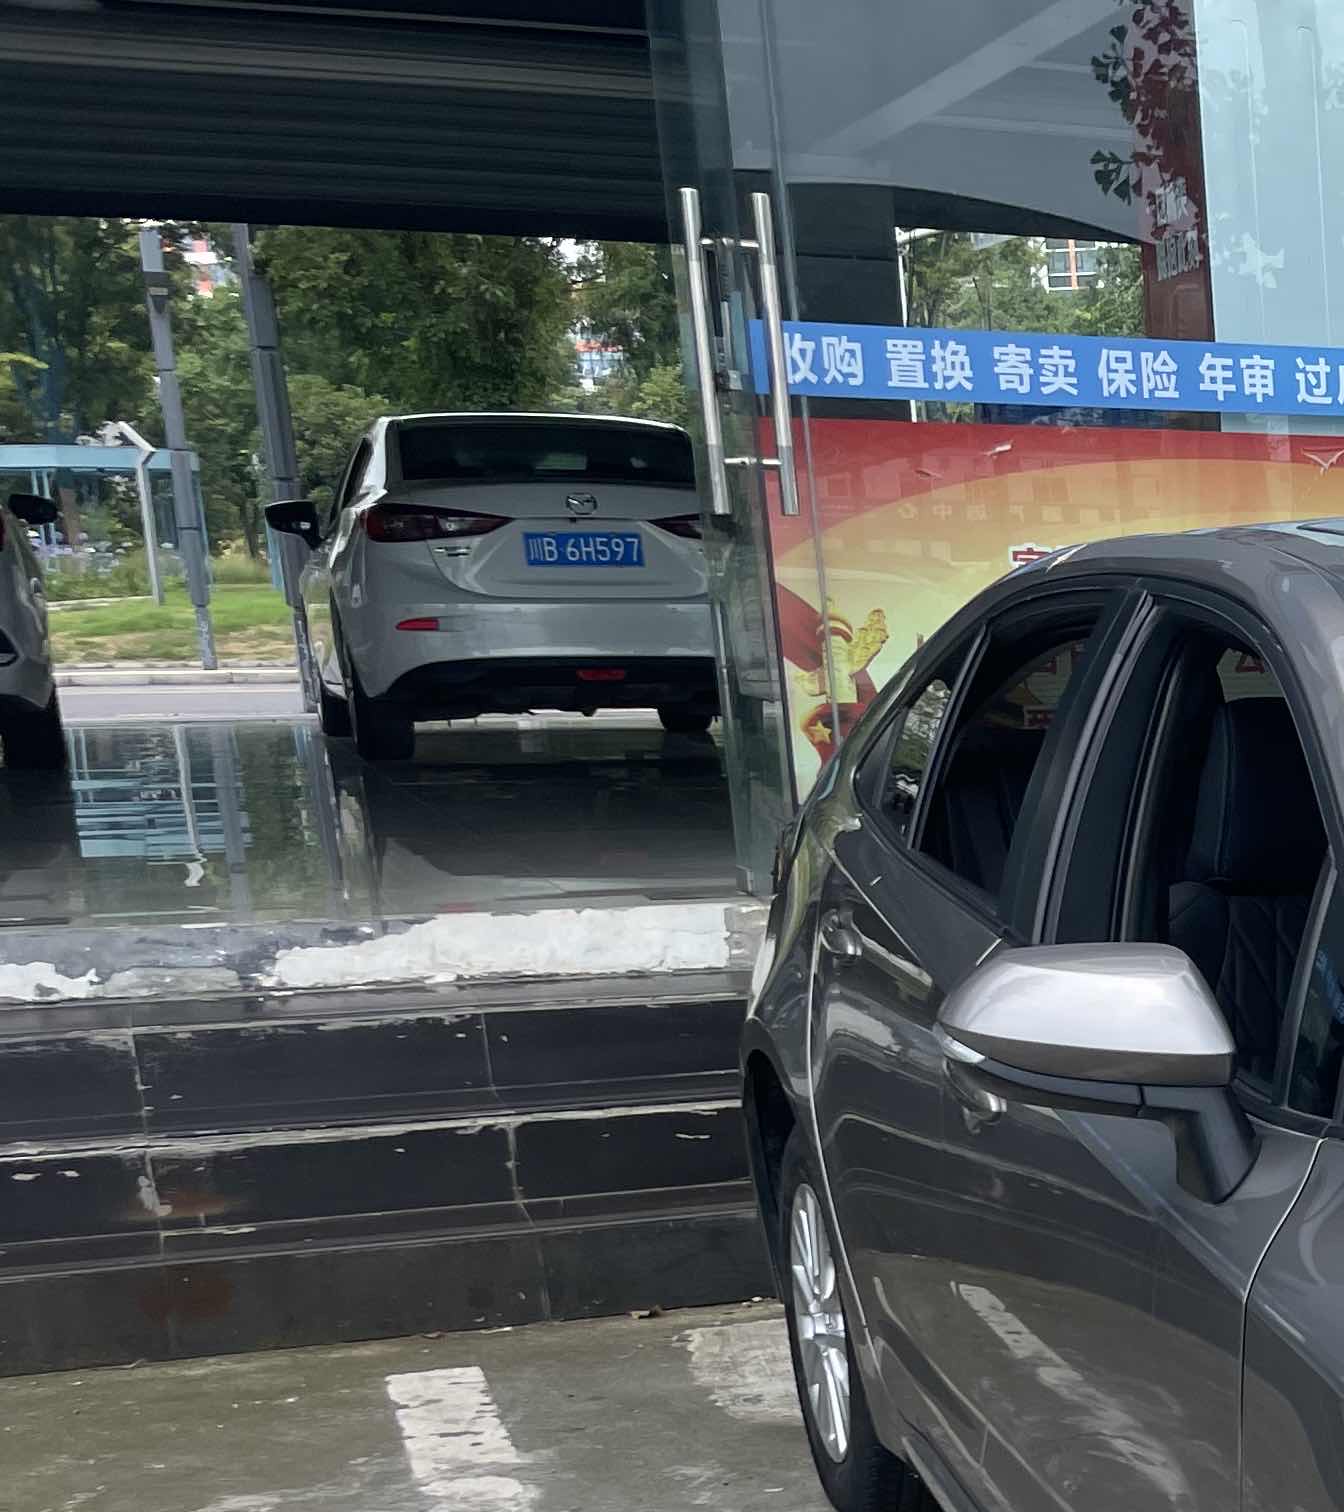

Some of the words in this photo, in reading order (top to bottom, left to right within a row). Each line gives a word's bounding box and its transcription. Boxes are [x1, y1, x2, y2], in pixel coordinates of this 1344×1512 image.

[786, 333, 863, 386] 收购
[886, 340, 973, 391] 置换
[993, 344, 1077, 395] 寄卖
[1098, 349, 1180, 398] 保险
[1199, 353, 1275, 402] 年审
